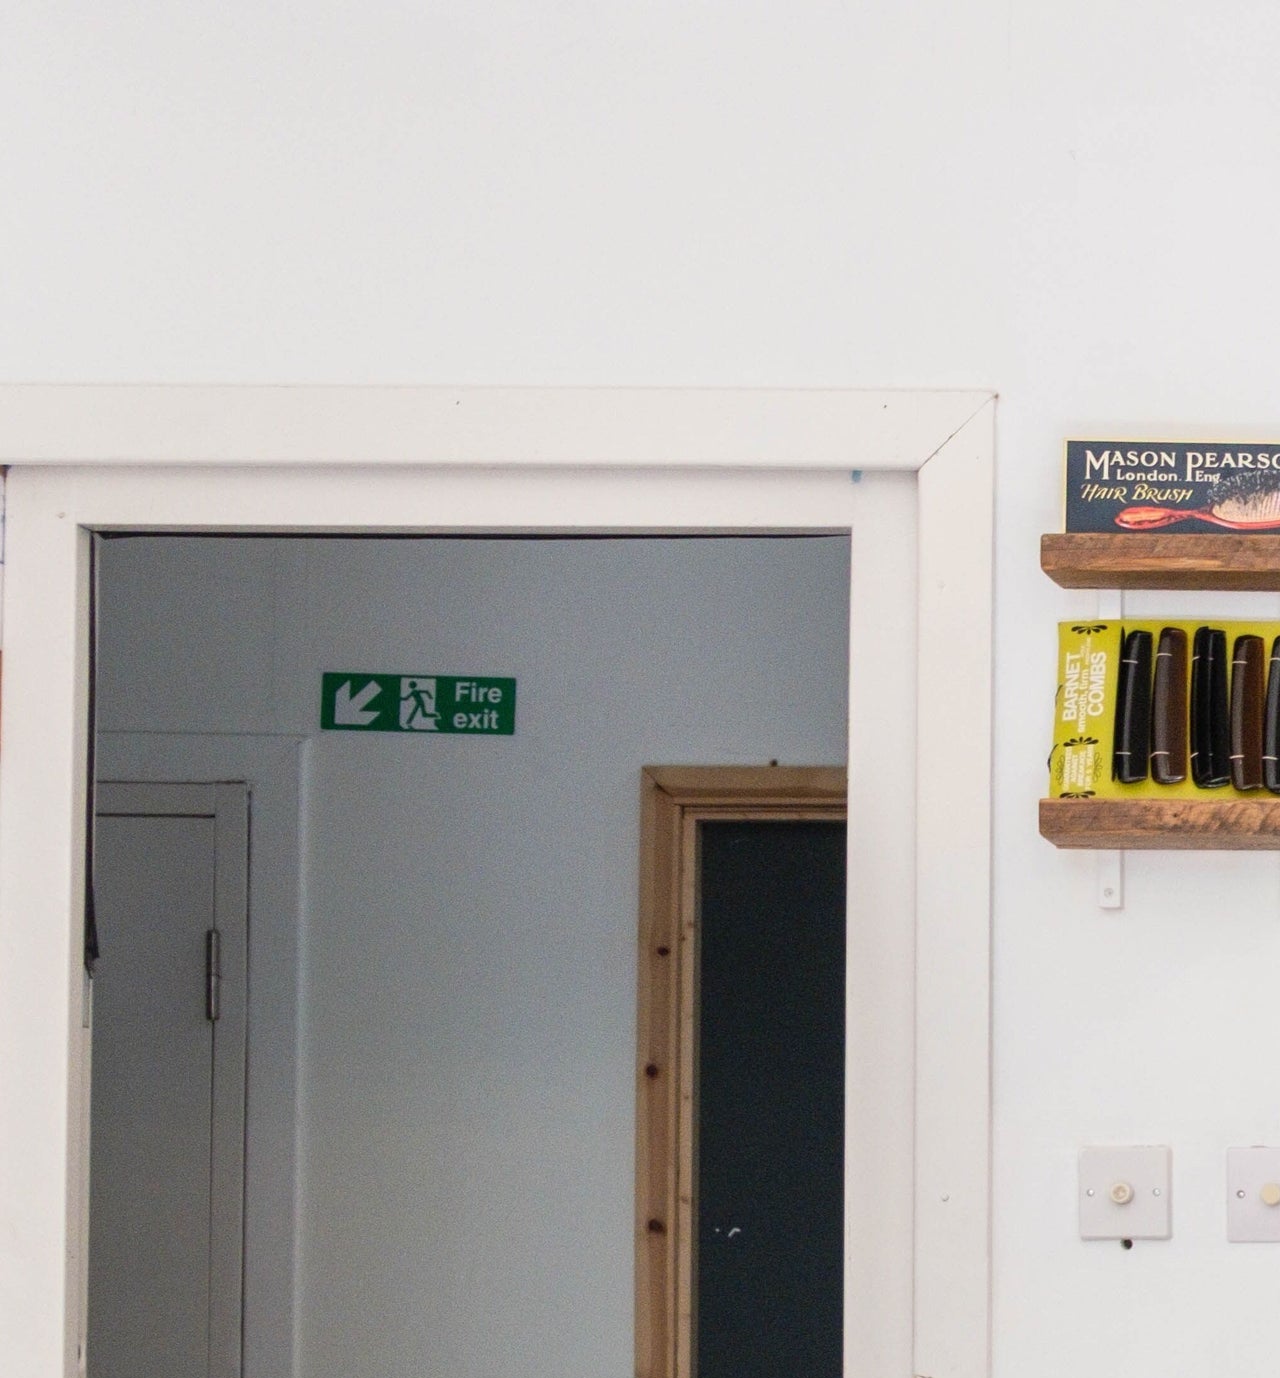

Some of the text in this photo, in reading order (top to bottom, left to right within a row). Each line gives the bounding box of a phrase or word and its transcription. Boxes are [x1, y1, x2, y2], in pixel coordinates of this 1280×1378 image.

[1085, 450, 1176, 481] MASON
[1081, 483, 1193, 504] HAIR BRUSH
[455, 682, 502, 704] Fire
[1062, 652, 1081, 722] BARNET
[1087, 651, 1107, 717] COMBS
[453, 708, 499, 730] exit
